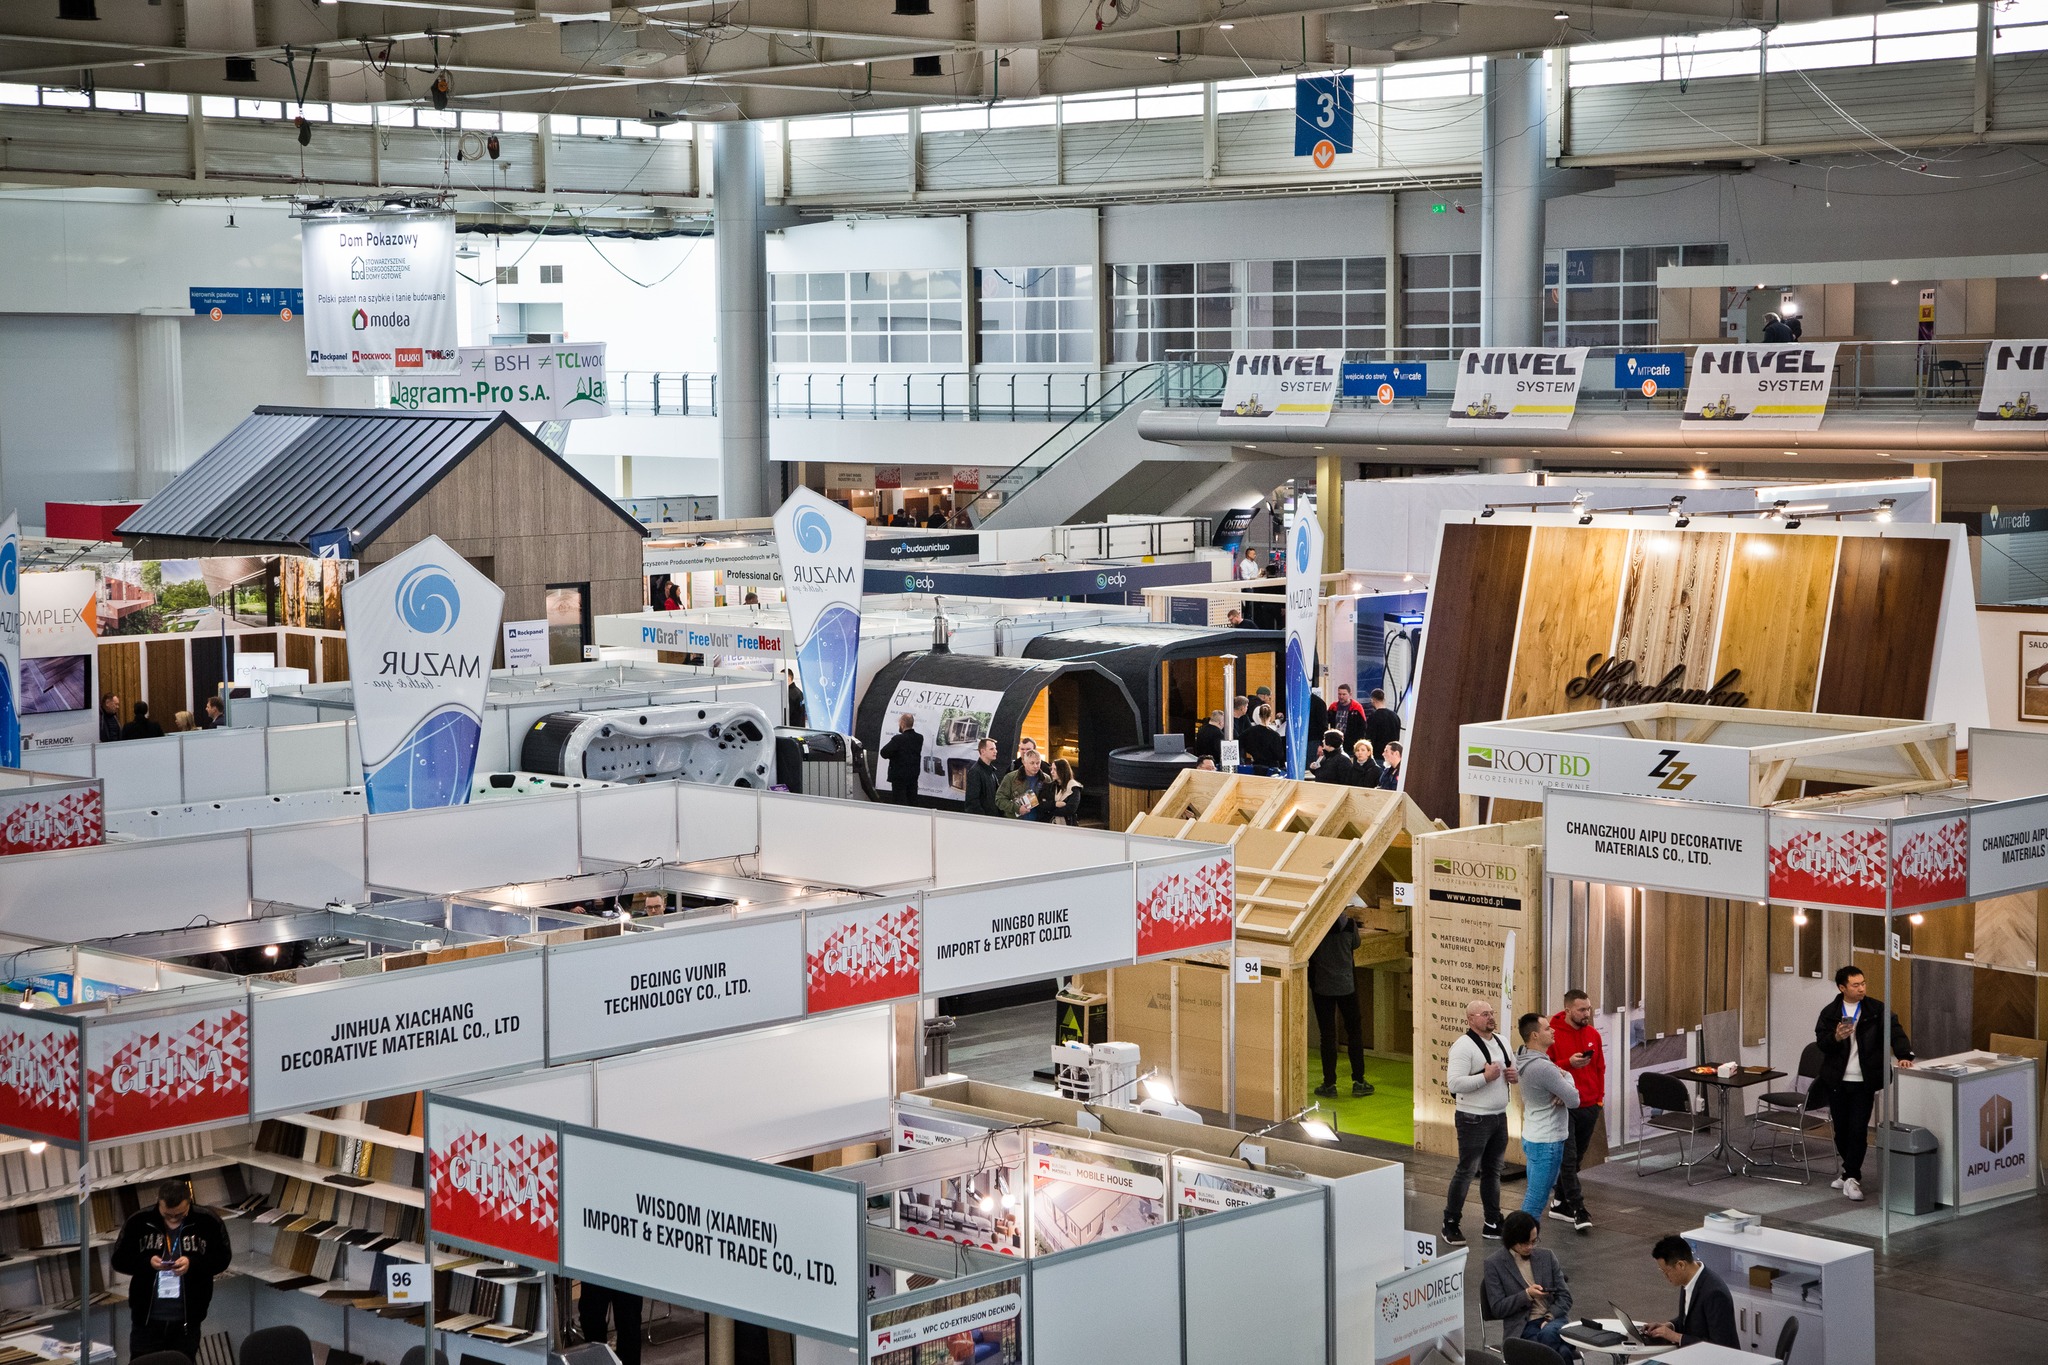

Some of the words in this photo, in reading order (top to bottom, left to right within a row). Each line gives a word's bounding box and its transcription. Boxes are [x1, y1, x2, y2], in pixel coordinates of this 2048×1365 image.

[1316, 93, 1335, 128] 3
[340, 232, 363, 247] Dom
[366, 232, 418, 248] Pokazowy
[318, 294, 337, 303] Polski
[338, 294, 357, 304] patent
[358, 295, 367, 303] na
[368, 294, 391, 304] szybkie
[396, 294, 411, 302] tanie
[413, 293, 446, 302] budowanie
[370, 311, 410, 327] modea
[320, 352, 348, 362] Rockpanel
[361, 353, 392, 361] ROCKWOOL
[495, 354, 530, 372] BSH
[1236, 354, 1334, 375] NIVEL
[1466, 352, 1576, 375] NIVEL
[1701, 349, 1825, 374] NIVEL
[1345, 373, 1364, 382] wejście
[1373, 373, 1387, 382] strefy
[1638, 364, 1670, 376] MTPcafe
[1281, 381, 1332, 392] SYSTEM
[1516, 380, 1575, 393] SYSTEM
[1757, 379, 1824, 392] SYSTEM
[395, 380, 514, 410] Jagram-Pro
[519, 384, 550, 401] S.A.
[2000, 512, 2030, 529] MTPcafe
[906, 543, 950, 554] budownictwo
[669, 557, 704, 566] Producentów
[705, 554, 715, 565] Płyt
[715, 553, 765, 564] Drewnopochodnych
[727, 570, 771, 581] Professional
[916, 575, 935, 592] edp
[1108, 571, 1126, 587] edp
[1289, 588, 1313, 611] MAZUR
[20, 608, 82, 626] OMPLEX
[25, 625, 76, 635] ARKET
[517, 628, 544, 636] Rockpanel
[737, 634, 781, 651] FreeHeat
[916, 690, 975, 709] SVELEN
[1468, 773, 1535, 786] ZAKORZENIENI
[1547, 780, 1590, 790] DREWNIE
[6, 814, 86, 843] CHINA
[1566, 821, 1638, 842] CHANGZHOU
[1639, 828, 1668, 846] AIPU
[1671, 832, 1743, 853] DECORATIVE
[1982, 831, 2031, 852] CHANGZHOU
[1595, 840, 1660, 860] MATERIALS
[1662, 846, 1685, 865] CO.,
[1688, 848, 1712, 866] LTD.
[1901, 845, 1956, 878] CHINA
[2002, 844, 2046, 864] MATERIALS
[1787, 848, 1870, 877] CHINA
[1395, 887, 1405, 896] 53
[1447, 893, 1504, 906] www.rootbd.pl
[1150, 888, 1217, 921] CHINA
[992, 912, 1035, 933] NINGBO
[1037, 908, 1069, 926] RUIKE
[937, 939, 981, 960] IMPORT
[983, 940, 992, 951] &
[994, 932, 1036, 952] EXPORT
[1440, 934, 1472, 944] MATERIAŁY
[1474, 938, 1505, 949] IZOLACYJN
[1440, 943, 1475, 953] NATURHELD
[823, 937, 902, 975] CHINA
[1440, 959, 1458, 967] PŁYTY
[1245, 962, 1258, 973] 94
[630, 968, 681, 991] DEQING
[685, 962, 727, 981] VUNIR
[1440, 975, 1466, 984] DREWNO
[604, 988, 692, 1016] TECHNOLOGY
[696, 983, 722, 1001] CO.,
[725, 978, 751, 997] LTD.
[331, 1016, 391, 1042] JINHUA
[395, 1002, 474, 1031] XIACHANG
[1441, 1016, 1458, 1024] PŁYTY
[1441, 1024, 1464, 1033] AGEPAN
[281, 1040, 378, 1072] DECORATIVE
[382, 1026, 459, 1055] MATERIAL
[462, 1022, 490, 1041] CO.,
[494, 1015, 521, 1035] LTD
[112, 1049, 224, 1094] CHINA
[1051, 1168, 1072, 1176] MATERIALS
[1967, 1160, 1990, 1177] AIPU
[1995, 1153, 2025, 1171] FLOOR
[449, 1156, 540, 1209] CHINA
[1076, 1168, 1105, 1182] MOBILE
[1107, 1174, 1133, 1188] HOUSE
[1198, 1197, 1220, 1205] MATERIALS
[636, 1193, 702, 1227] WISDOM
[706, 1210, 778, 1248] (XIAMEN)
[583, 1207, 638, 1239] IMPORT
[642, 1223, 653, 1241] &
[657, 1225, 714, 1257] EXPORT
[717, 1239, 768, 1270] TRADE
[773, 1253, 802, 1280] CO.,
[807, 1259, 837, 1287] LTD.
[1417, 1240, 1433, 1256] 95
[392, 1271, 412, 1287] 96
[922, 1324, 938, 1335] WPC
[939, 1310, 987, 1331] CO-EXTRUSION
[988, 1303, 1016, 1317] DECKING
[893, 1332, 917, 1343] MATERIALS
